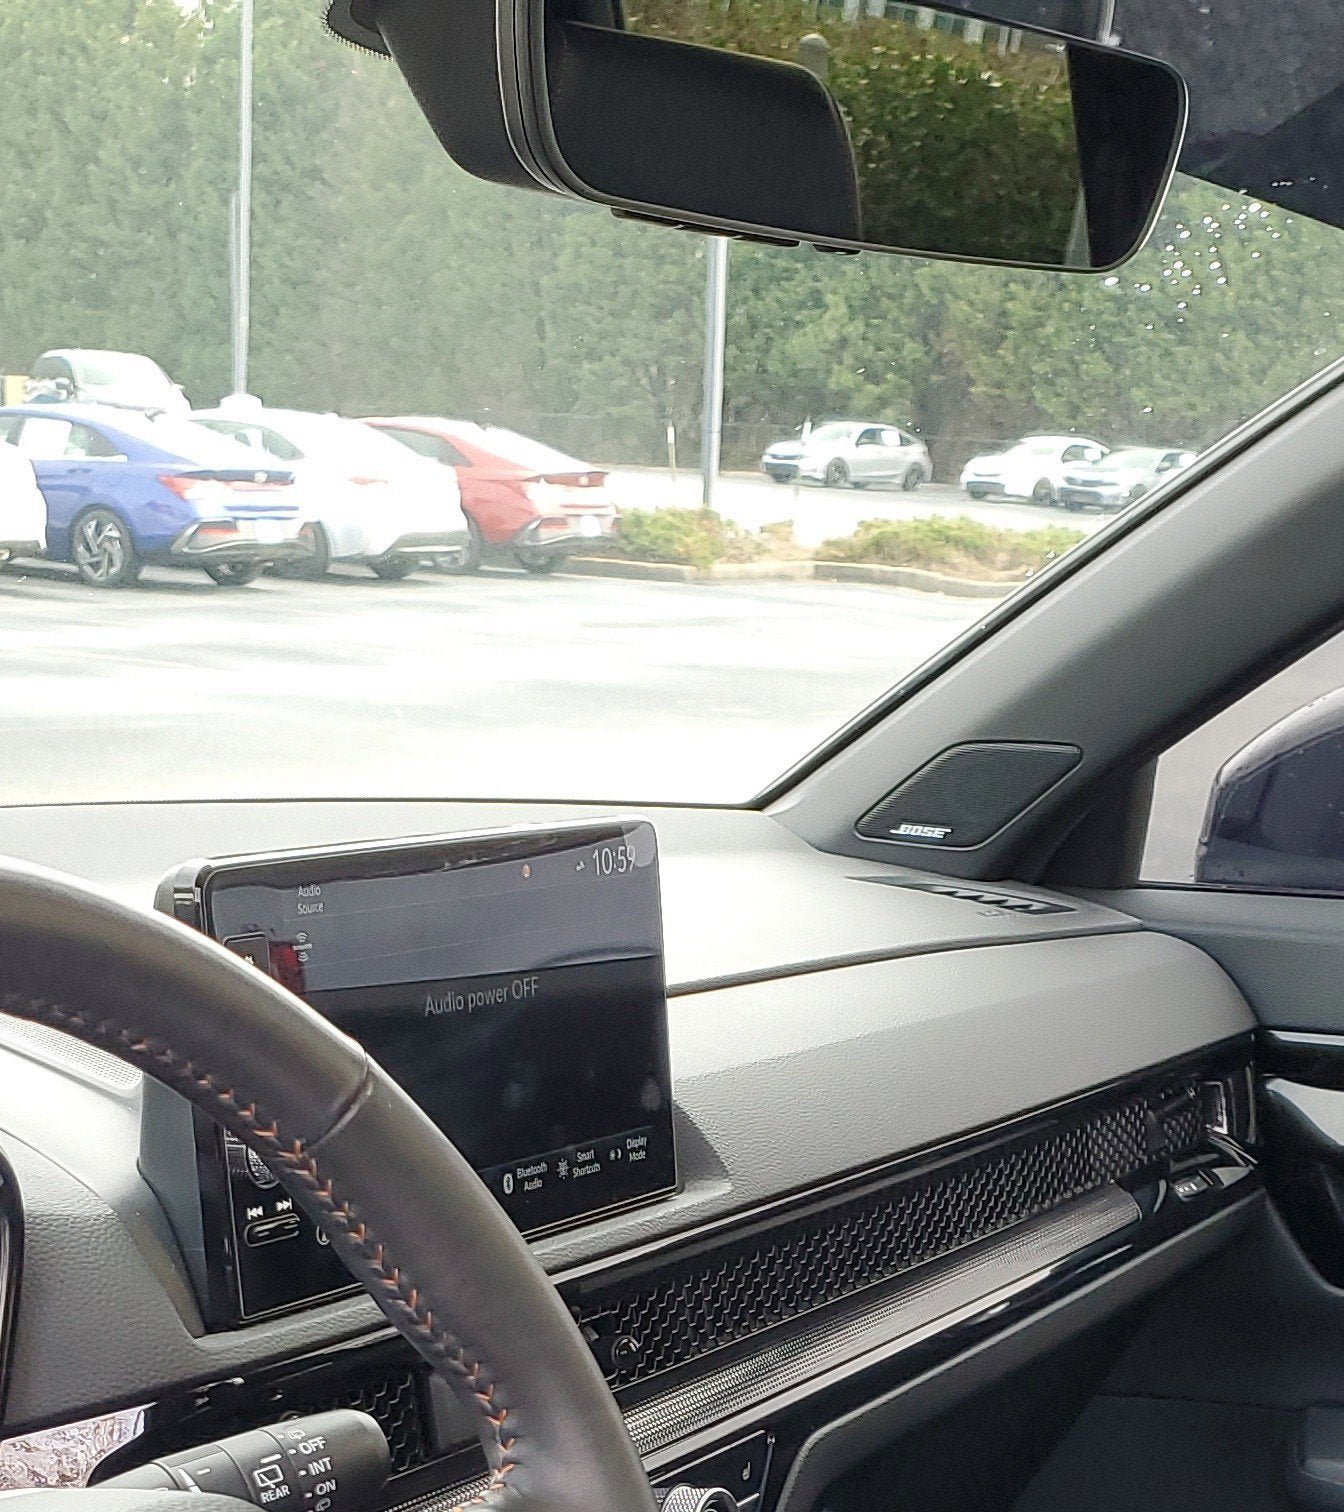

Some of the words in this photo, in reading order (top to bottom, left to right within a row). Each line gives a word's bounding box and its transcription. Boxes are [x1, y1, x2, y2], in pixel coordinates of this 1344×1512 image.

[890, 824, 952, 839] BOSE
[592, 845, 636, 876] 10:59
[297, 884, 322, 897] Audio
[297, 902, 324, 915] Source
[424, 991, 464, 1017] Audio
[468, 986, 509, 1012] power
[512, 976, 539, 999] OFF
[626, 1135, 648, 1150] Display
[576, 1149, 595, 1163] Smart
[629, 1150, 646, 1162] Mode
[516, 1161, 548, 1179] Bluetooth
[572, 1163, 601, 1179] Shortcuts
[523, 1178, 543, 1191] Audio
[298, 1436, 327, 1455] OFF
[308, 1457, 333, 1476] INT
[259, 1485, 291, 1504] REAR
[315, 1479, 337, 1496] ON
